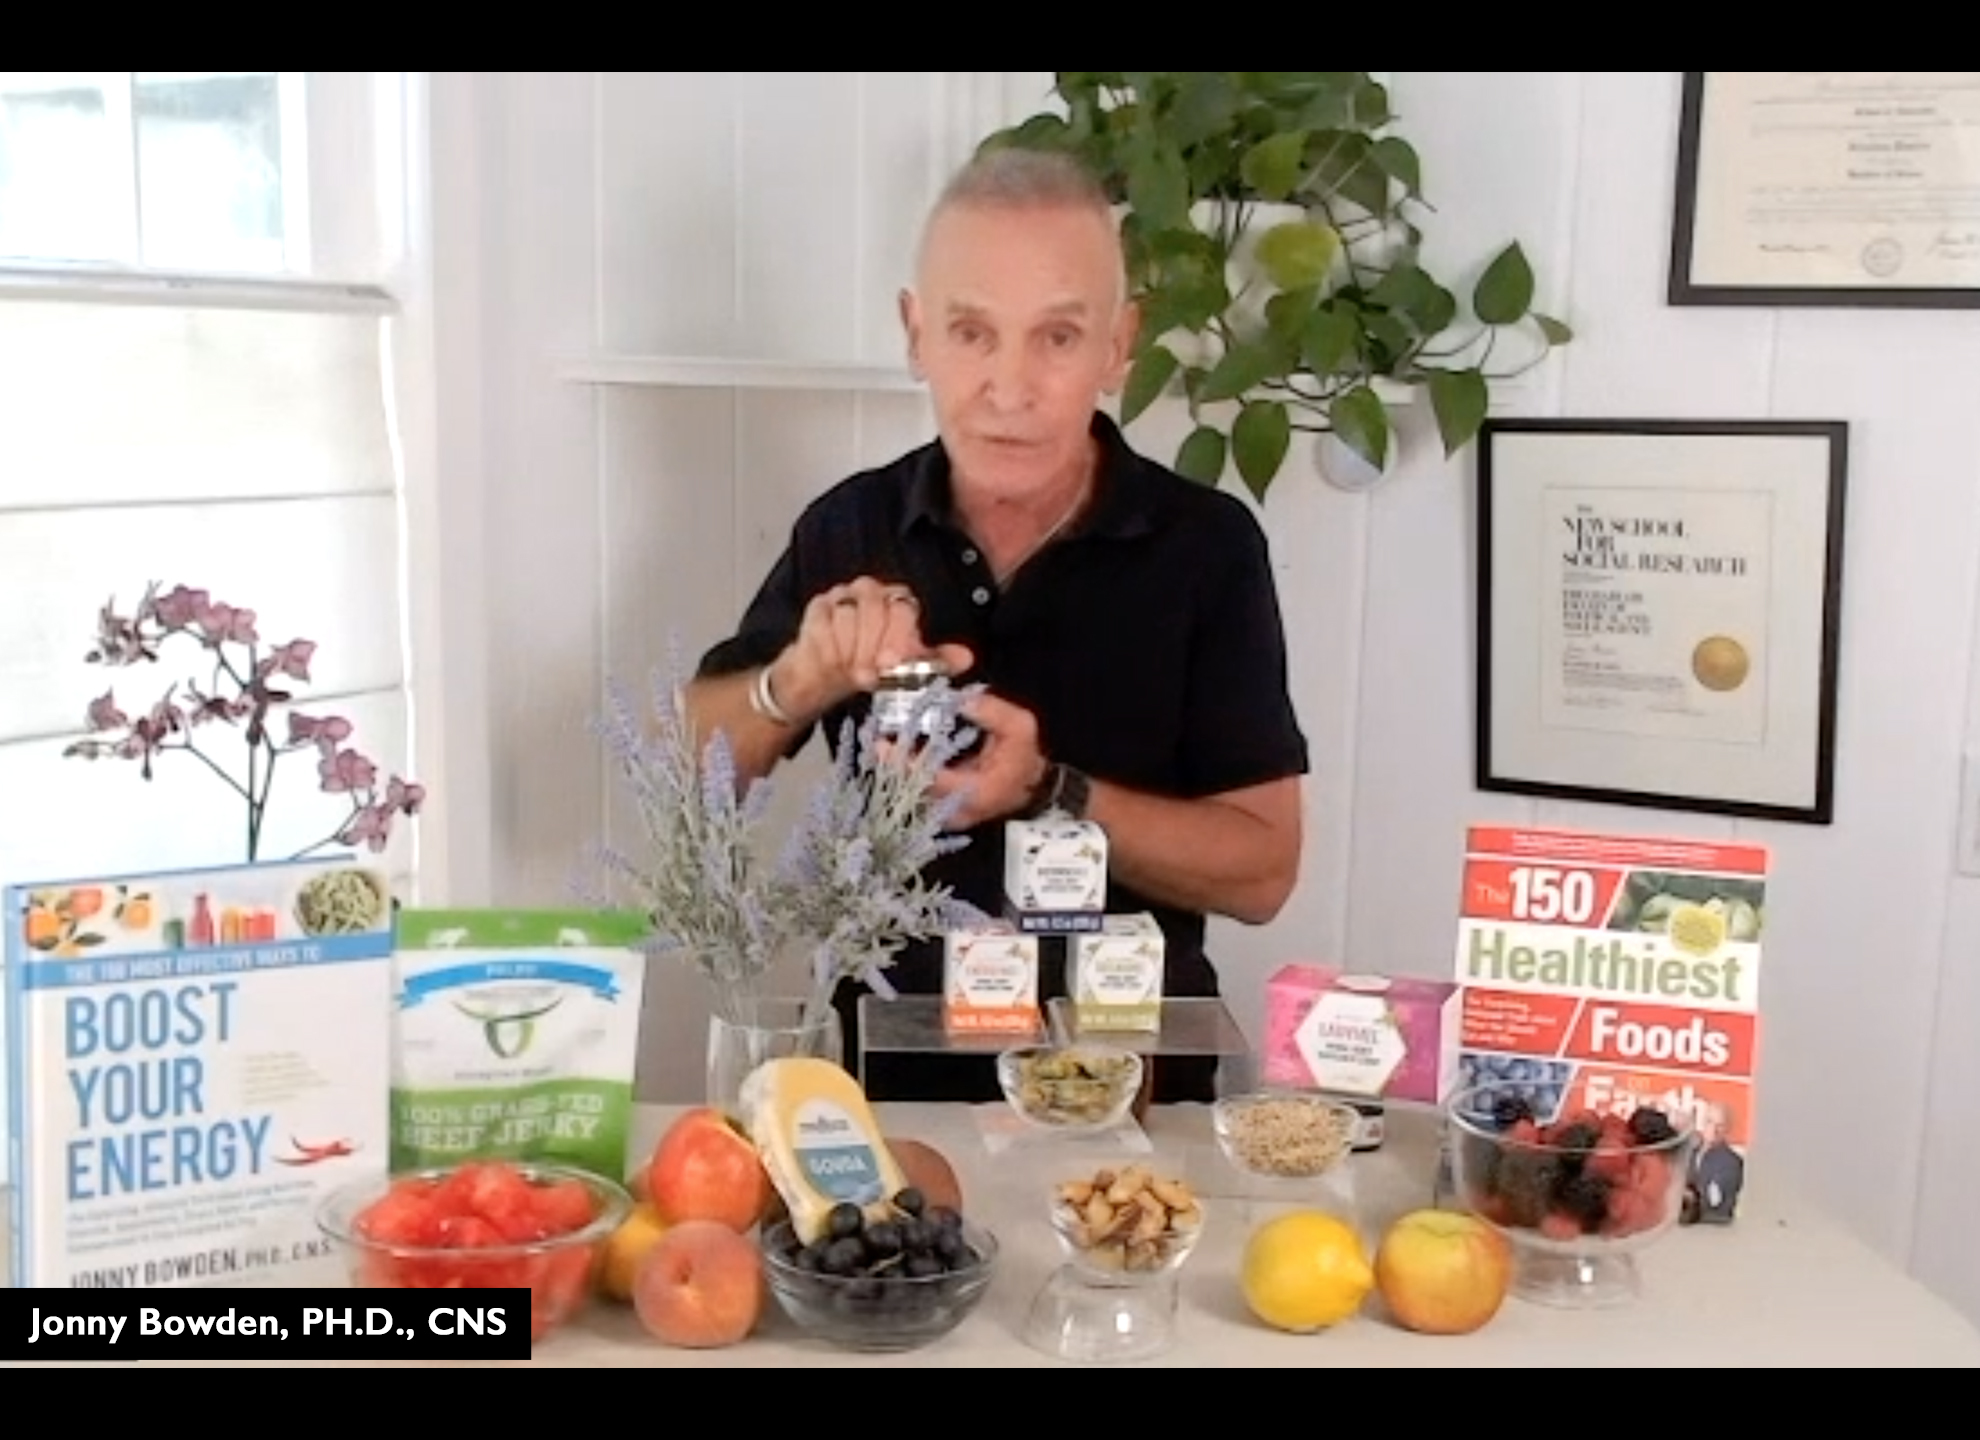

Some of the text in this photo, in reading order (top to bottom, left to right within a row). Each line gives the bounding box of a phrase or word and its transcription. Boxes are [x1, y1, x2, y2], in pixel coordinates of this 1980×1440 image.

[1563, 516, 1684, 537] NEW SCHOOL
[1563, 553, 1747, 577] SOCIAL RESEARCH
[1477, 867, 1595, 924] The 150
[130, 956, 172, 978] MOST
[1467, 927, 1743, 1002] Healthiest
[66, 982, 238, 1060] BOOST
[1590, 1006, 1731, 1068] Foods
[67, 1054, 205, 1129] YOUR
[67, 1114, 272, 1202] ENERGY
[401, 1112, 602, 1151] BEEF JERKY
